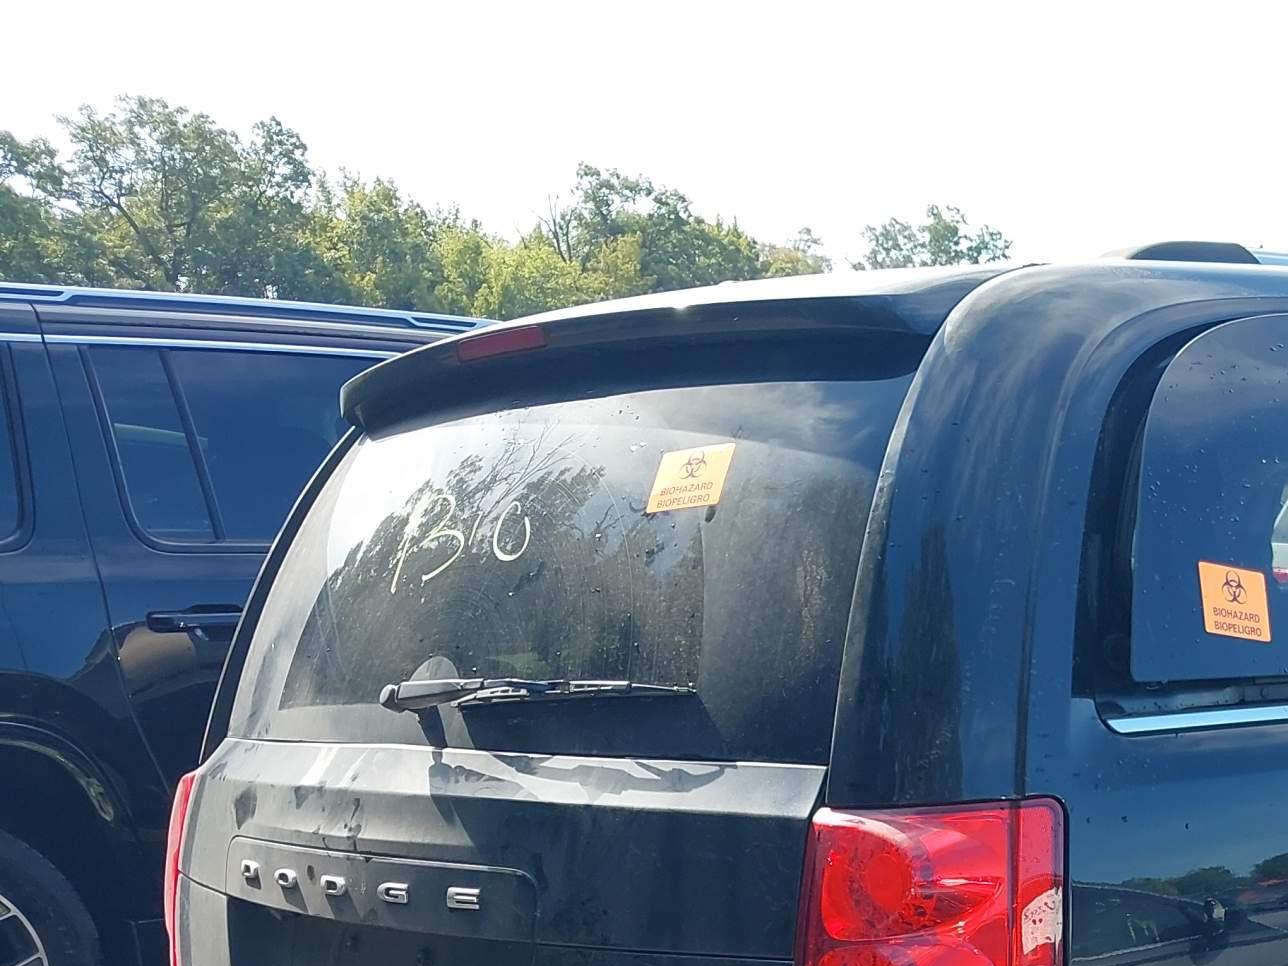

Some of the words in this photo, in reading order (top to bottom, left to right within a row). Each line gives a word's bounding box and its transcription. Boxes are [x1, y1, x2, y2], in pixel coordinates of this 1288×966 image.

[660, 481, 714, 497] BIOHAZARD
[656, 493, 710, 509] BIOPELIGRO
[1212, 606, 1260, 624] BIOHAZARD
[1214, 621, 1262, 637] BIOPELIGRO
[240, 858, 481, 911] DODGE
